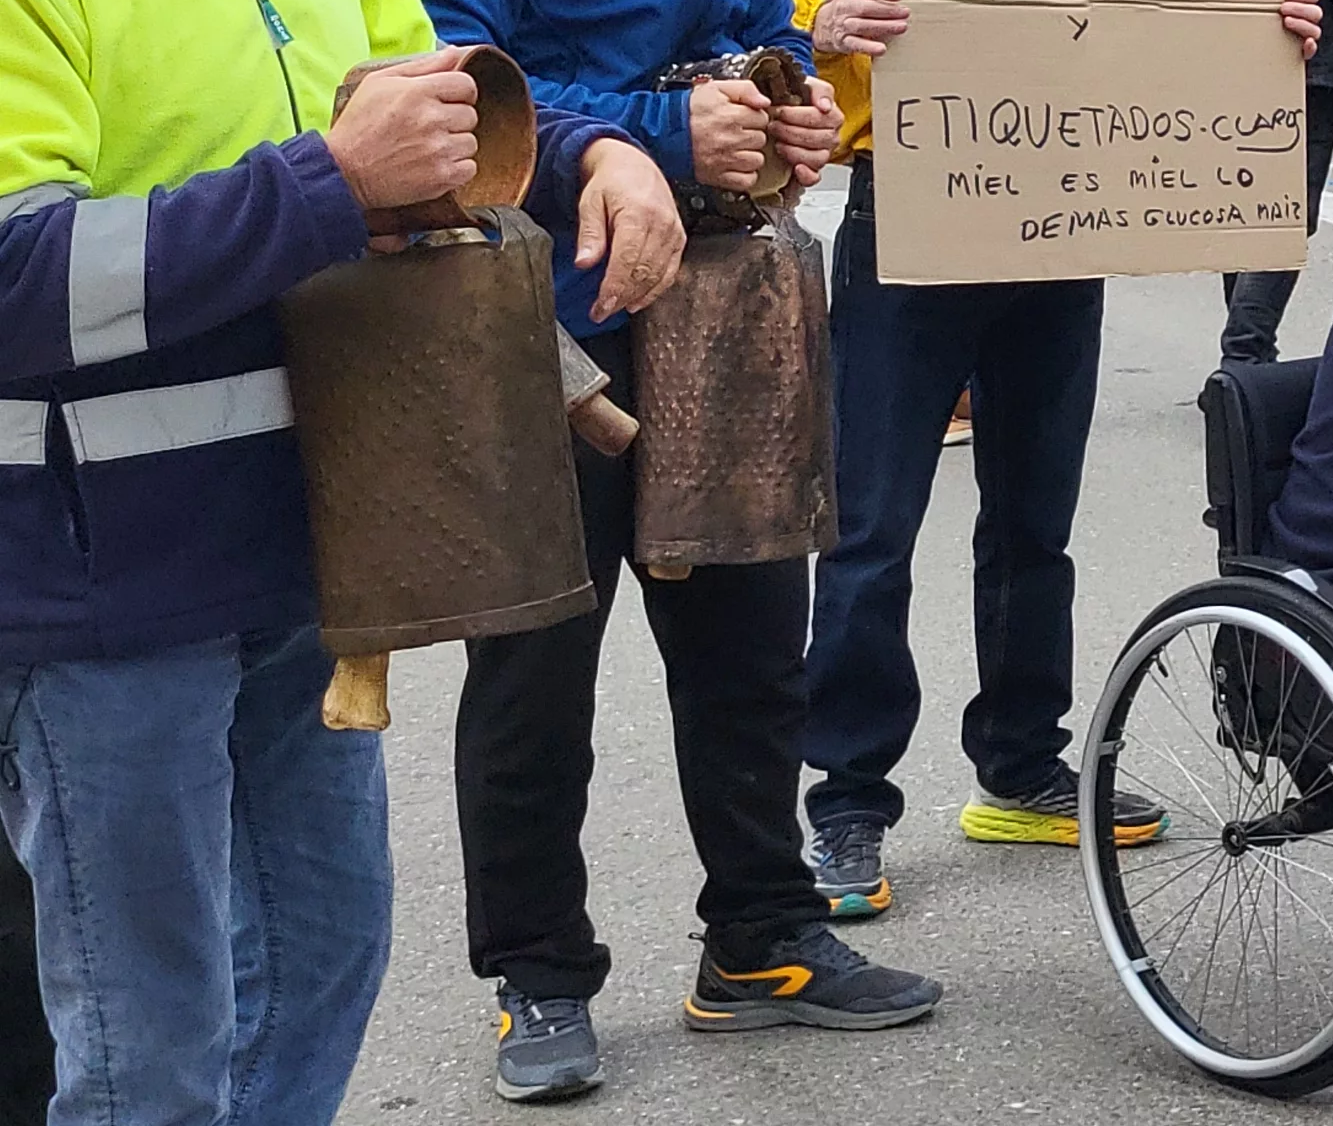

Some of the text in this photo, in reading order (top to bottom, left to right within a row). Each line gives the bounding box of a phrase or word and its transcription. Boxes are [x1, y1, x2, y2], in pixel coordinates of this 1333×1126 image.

[1067, 14, 1090, 40] Y
[1061, 173, 1100, 193] ES
[1216, 166, 1255, 188] LO
[1020, 210, 1129, 242] DEMAS
[1143, 204, 1246, 226] GLUCOSA
